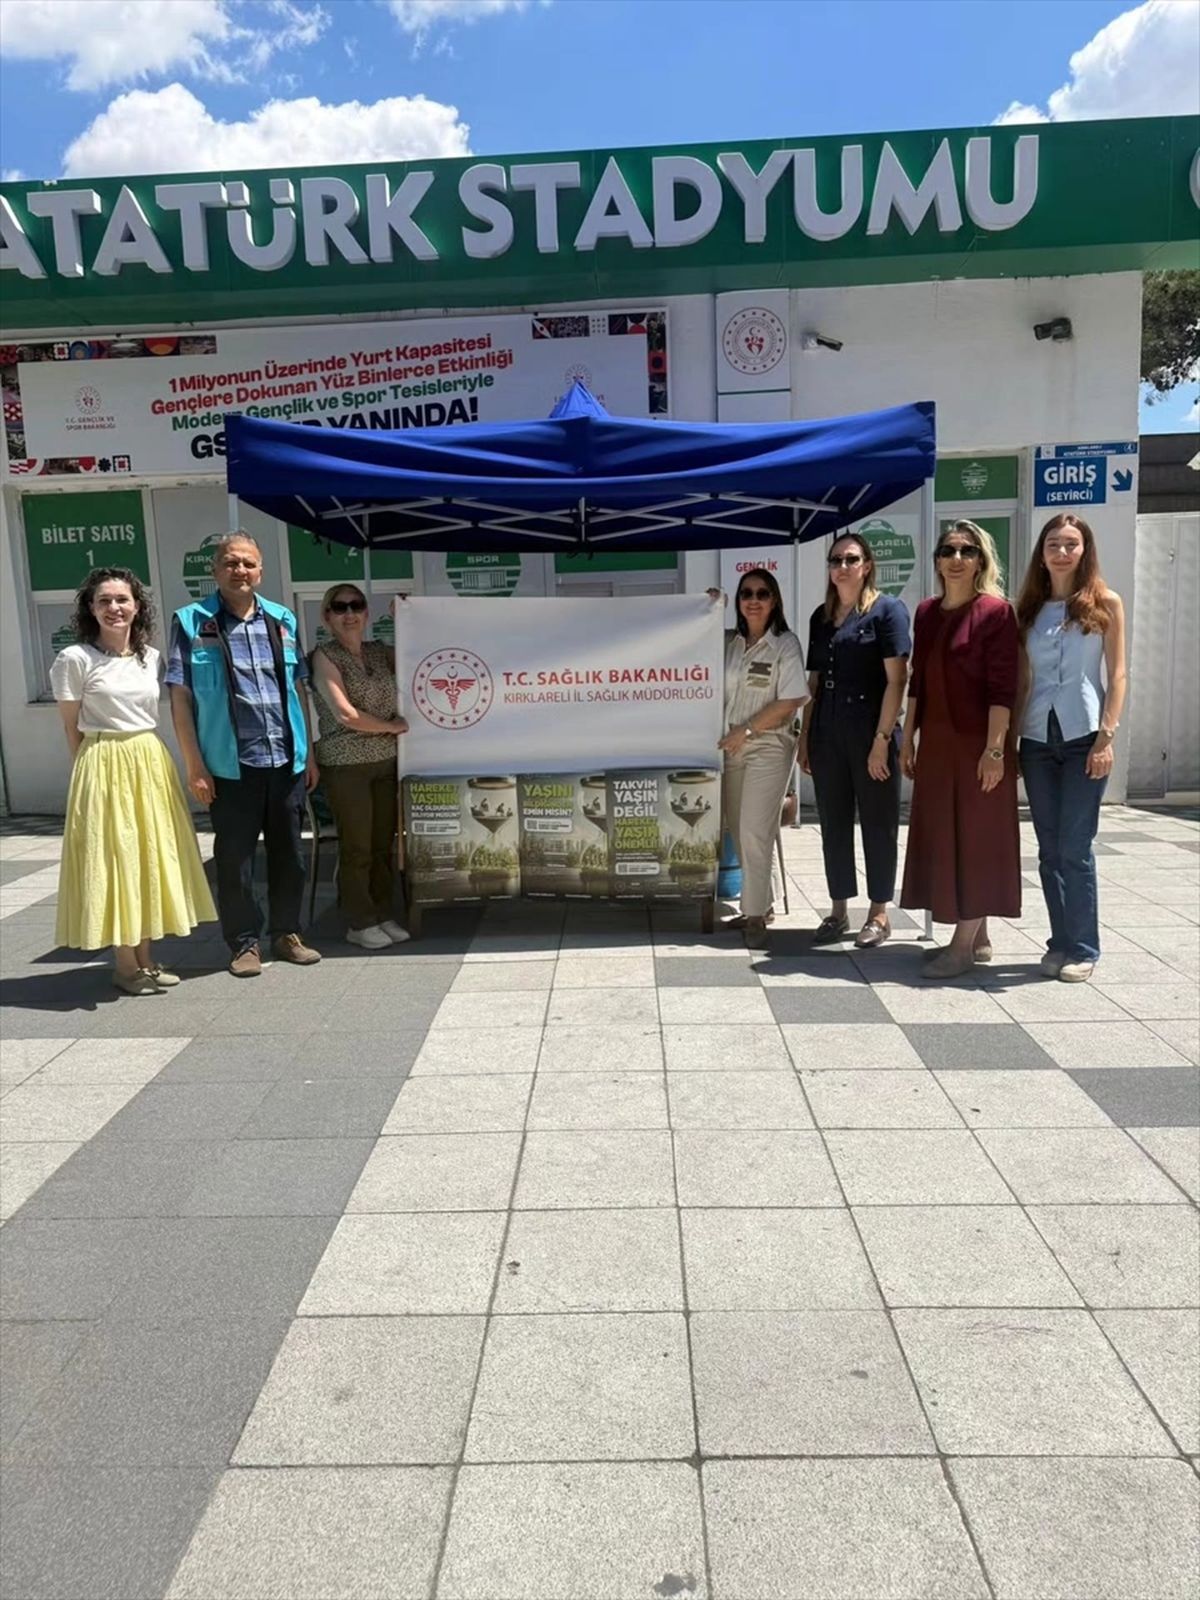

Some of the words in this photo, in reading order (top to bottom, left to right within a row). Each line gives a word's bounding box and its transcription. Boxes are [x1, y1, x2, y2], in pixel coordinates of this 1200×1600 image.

[0, 170, 439, 279] ATATÜRK
[458, 134, 1040, 260] STADYUMU
[169, 378, 177, 393] 1
[180, 368, 262, 392] Milyonun
[265, 355, 347, 379] Üzerinde
[350, 349, 393, 367] Yurt
[396, 333, 492, 361] Kapasitesi
[151, 391, 233, 415] Gençlere
[236, 380, 317, 403] Dokunan
[321, 373, 355, 390] Yüz
[358, 362, 435, 386] Binlerce
[438, 349, 513, 374] Etkinliği
[246, 397, 314, 420] Gençlik
[317, 395, 339, 410] ve
[342, 388, 387, 409] Spor
[389, 373, 494, 400] Tesisleriyle
[1043, 460, 1097, 487] GİRİŞ
[1046, 488, 1093, 503] (SEYİRCİ)
[42, 524, 85, 544] BİLET
[91, 524, 135, 545] SATIŞ
[86, 549, 94, 567] 1
[502, 672, 533, 686] T.C.
[537, 668, 603, 685] SAĞLIK
[608, 665, 710, 683] BAKANLIĞI
[504, 689, 571, 704] KIRKLARELİ
[587, 686, 629, 703] SAĞLIK
[632, 685, 713, 701] MÜDÜRLÜĞÜ
[613, 779, 657, 789] TAKVİM
[614, 790, 658, 804] YAŞIN
[614, 803, 658, 817] DEĞİL
[616, 826, 658, 838] YAŞIN
